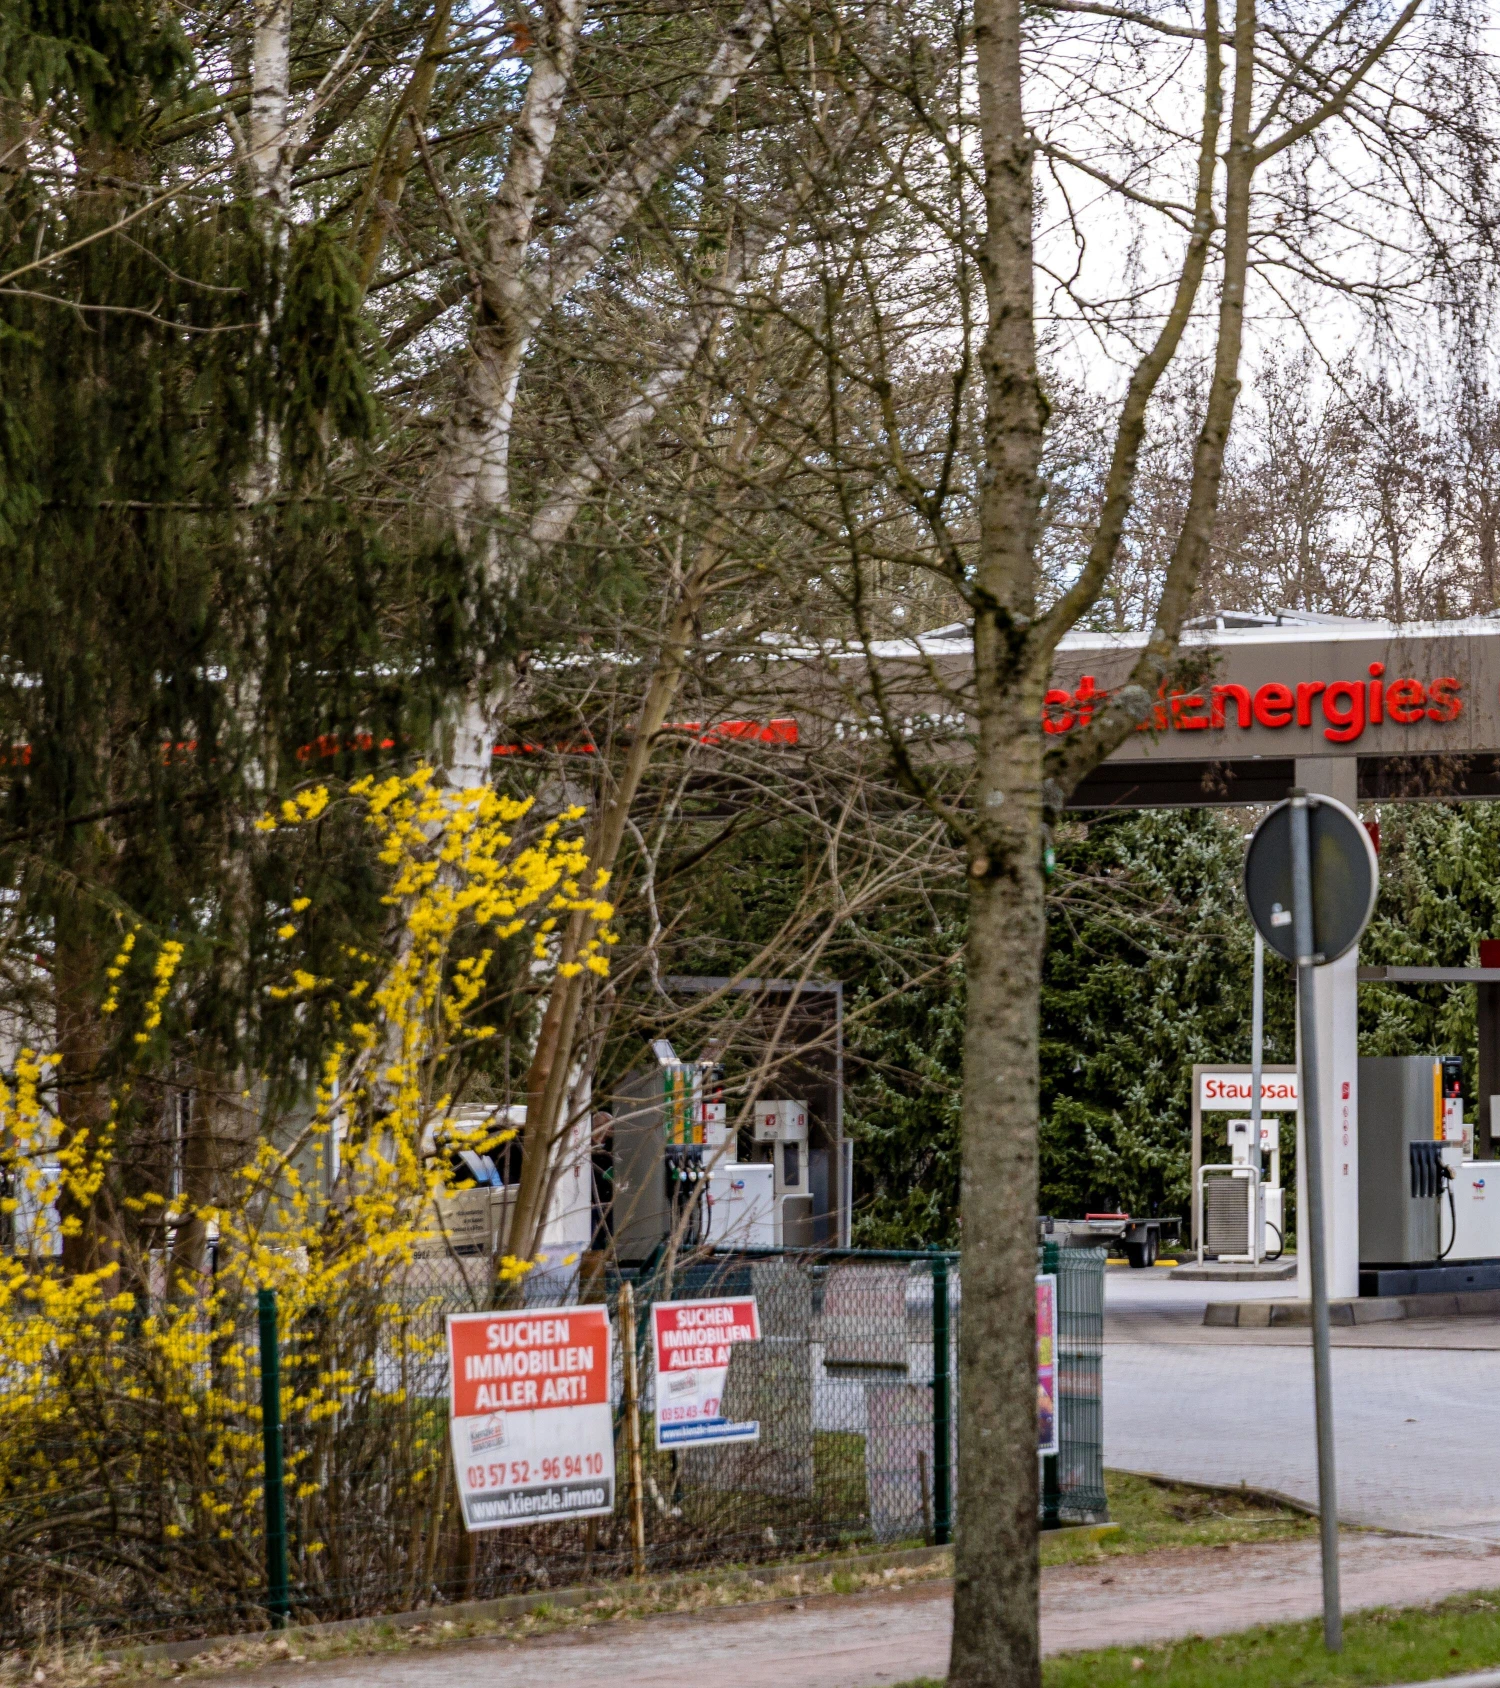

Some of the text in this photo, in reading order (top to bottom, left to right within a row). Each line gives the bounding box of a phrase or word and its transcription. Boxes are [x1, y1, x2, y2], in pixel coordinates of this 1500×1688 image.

[676, 1306, 734, 1328] SUCHEN
[486, 1319, 570, 1349] SUCHEN
[662, 1325, 751, 1349] IMMOBILIEN
[465, 1346, 594, 1381] IMMOBILIEN
[668, 1347, 714, 1368] ALLER
[475, 1375, 588, 1410] ALLER ART!
[703, 1397, 720, 1416] 47
[467, 1465, 486, 1489] 03
[489, 1463, 506, 1487] 57
[512, 1460, 530, 1484] 52
[541, 1458, 560, 1481] 96
[565, 1455, 582, 1477] 94
[585, 1452, 604, 1475] 10
[472, 1487, 605, 1521] www.kienzle.immo
